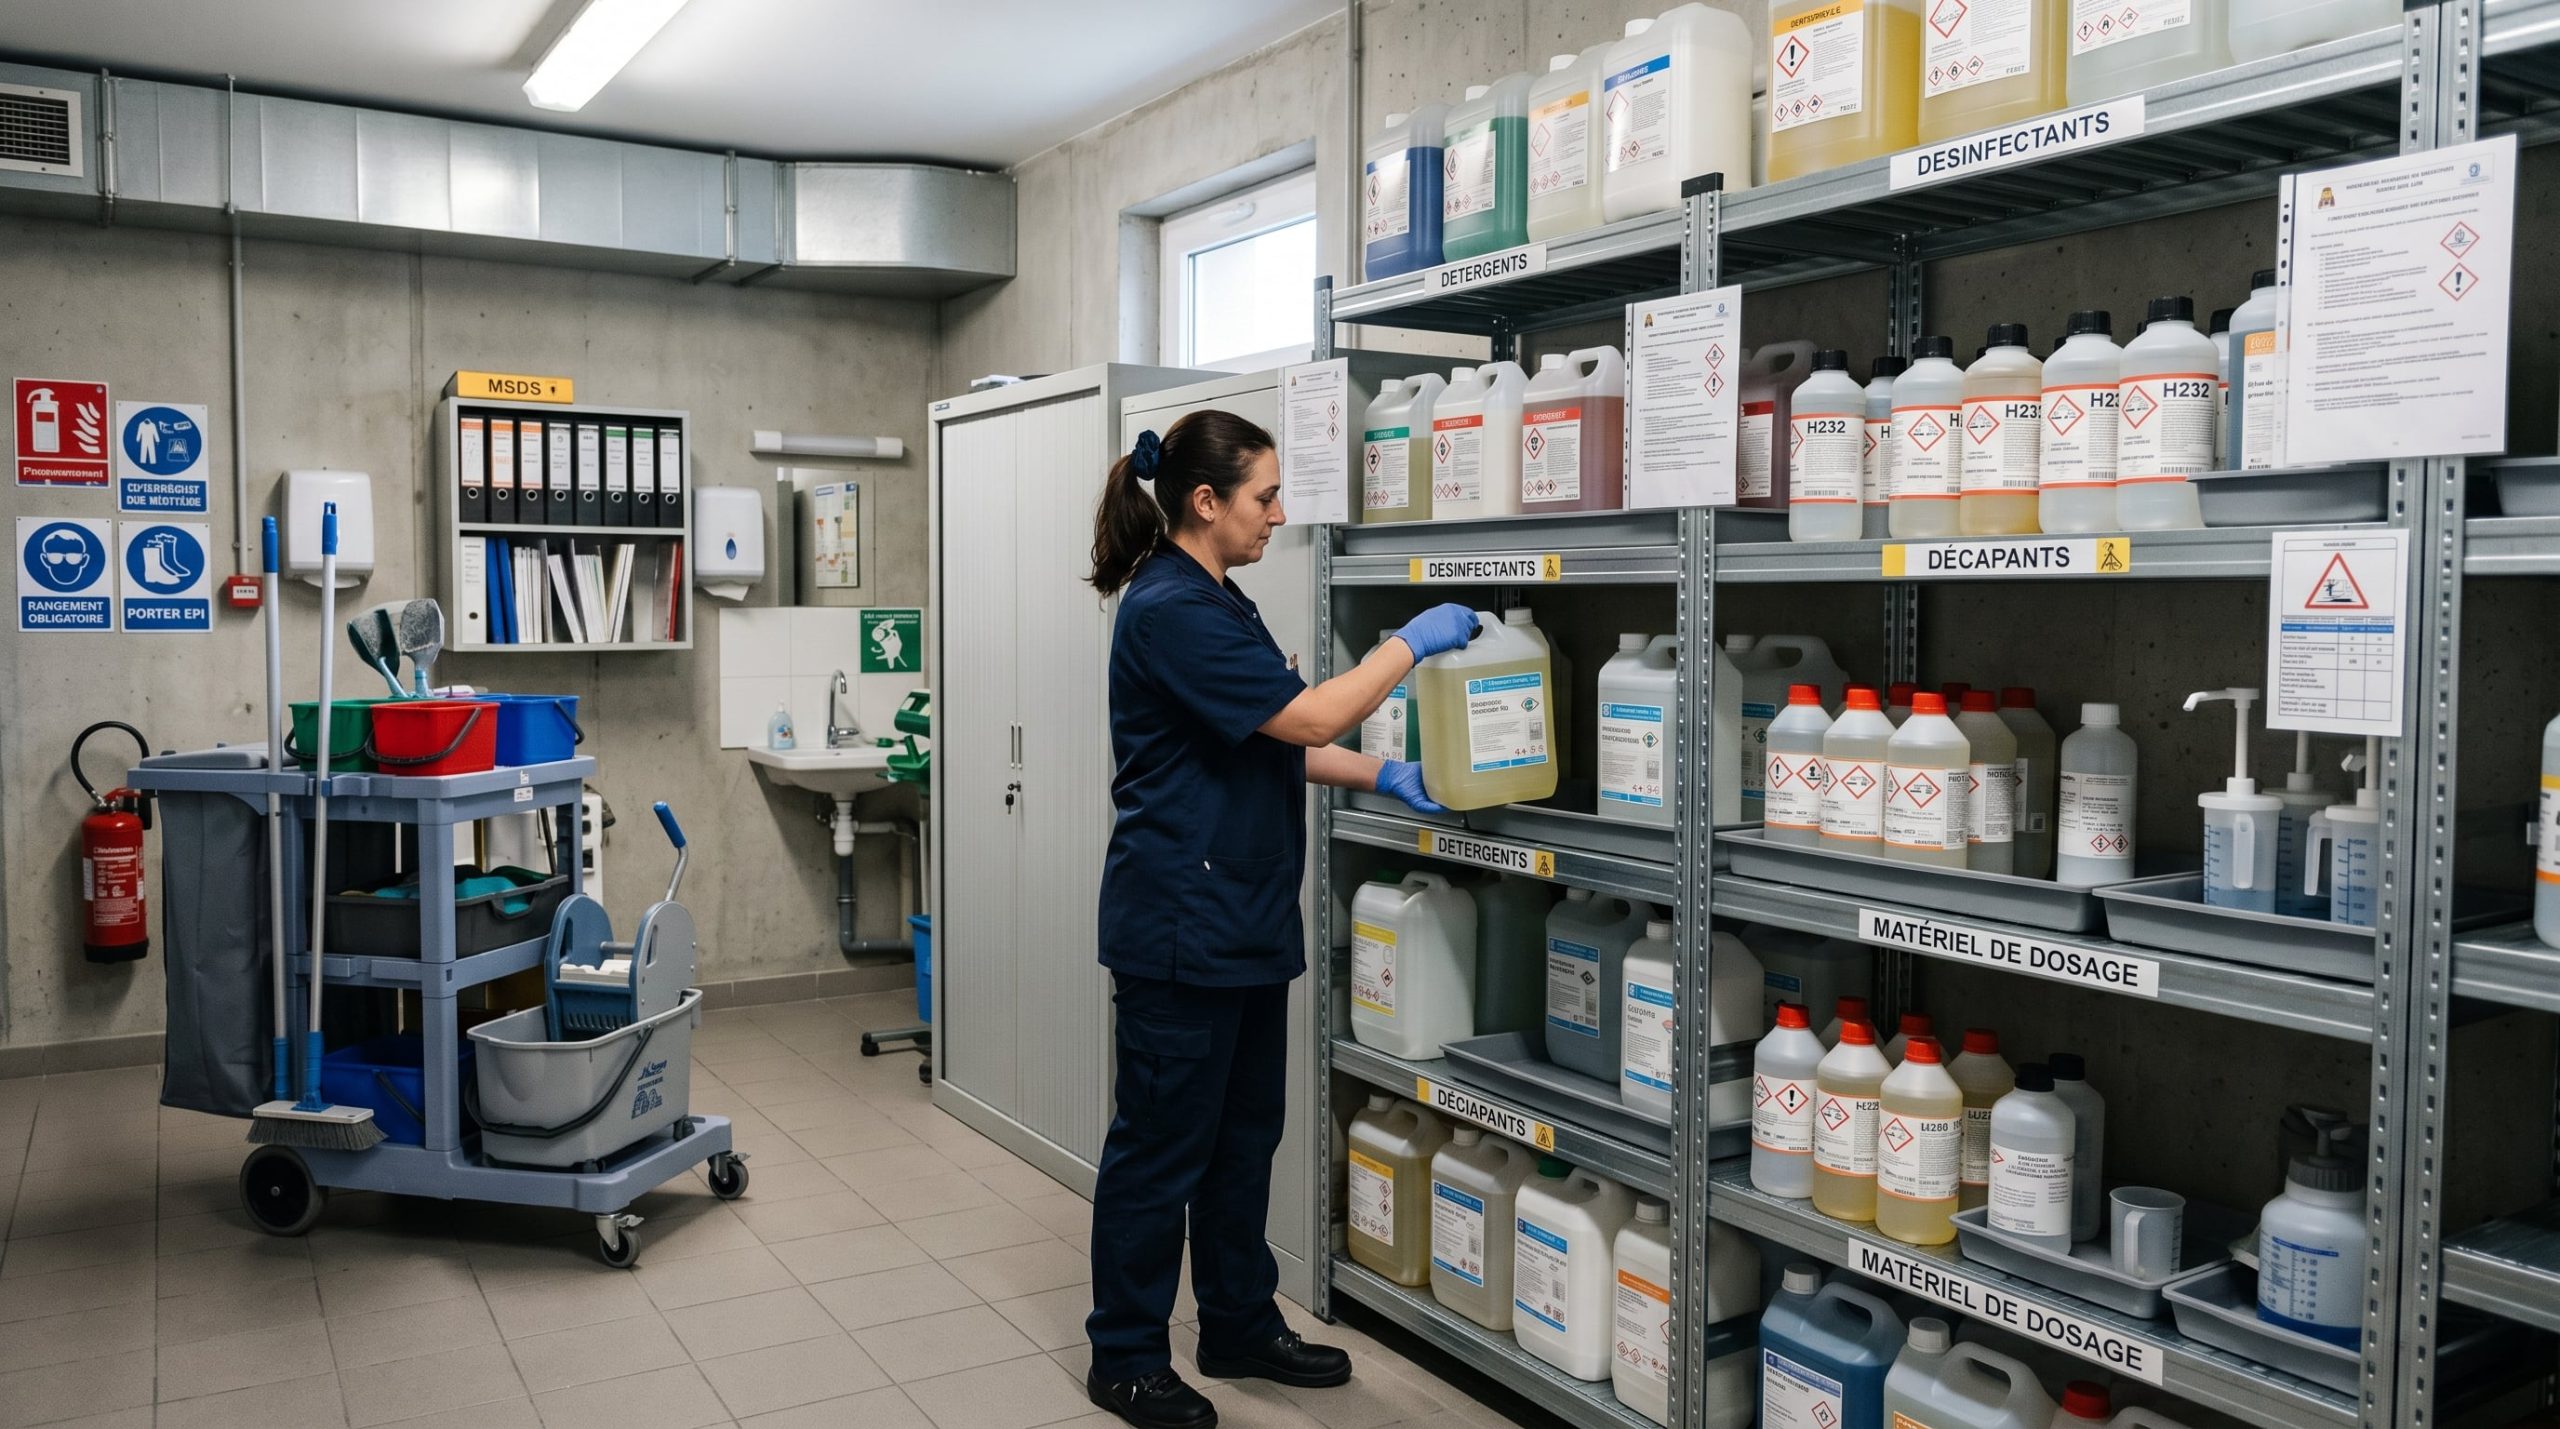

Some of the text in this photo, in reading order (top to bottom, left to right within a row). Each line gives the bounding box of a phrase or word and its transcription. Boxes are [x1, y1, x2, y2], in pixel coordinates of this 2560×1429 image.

[1918, 111, 2110, 176] DESINFECTANTS
[1441, 253, 1527, 287] DETERGENTS
[488, 378, 541, 395] MSDS
[2163, 382, 2210, 398] H232
[2090, 392, 2120, 407] H23
[1807, 420, 1846, 434] H232
[1929, 544, 2070, 569] DÉCAPANTS
[28, 601, 104, 611] RANGEMENT
[127, 607, 205, 620] PORTER EPI
[28, 613, 104, 624] OBLIGATOIRE
[1438, 837, 1527, 868] DETERGENTS
[1873, 917, 2139, 987] MATÉRIEL DE DOSAGE
[1438, 1089, 1526, 1136] DÉCIAPANTS
[1861, 1248, 2143, 1371] MATÉRIEL DE DOSAGE
